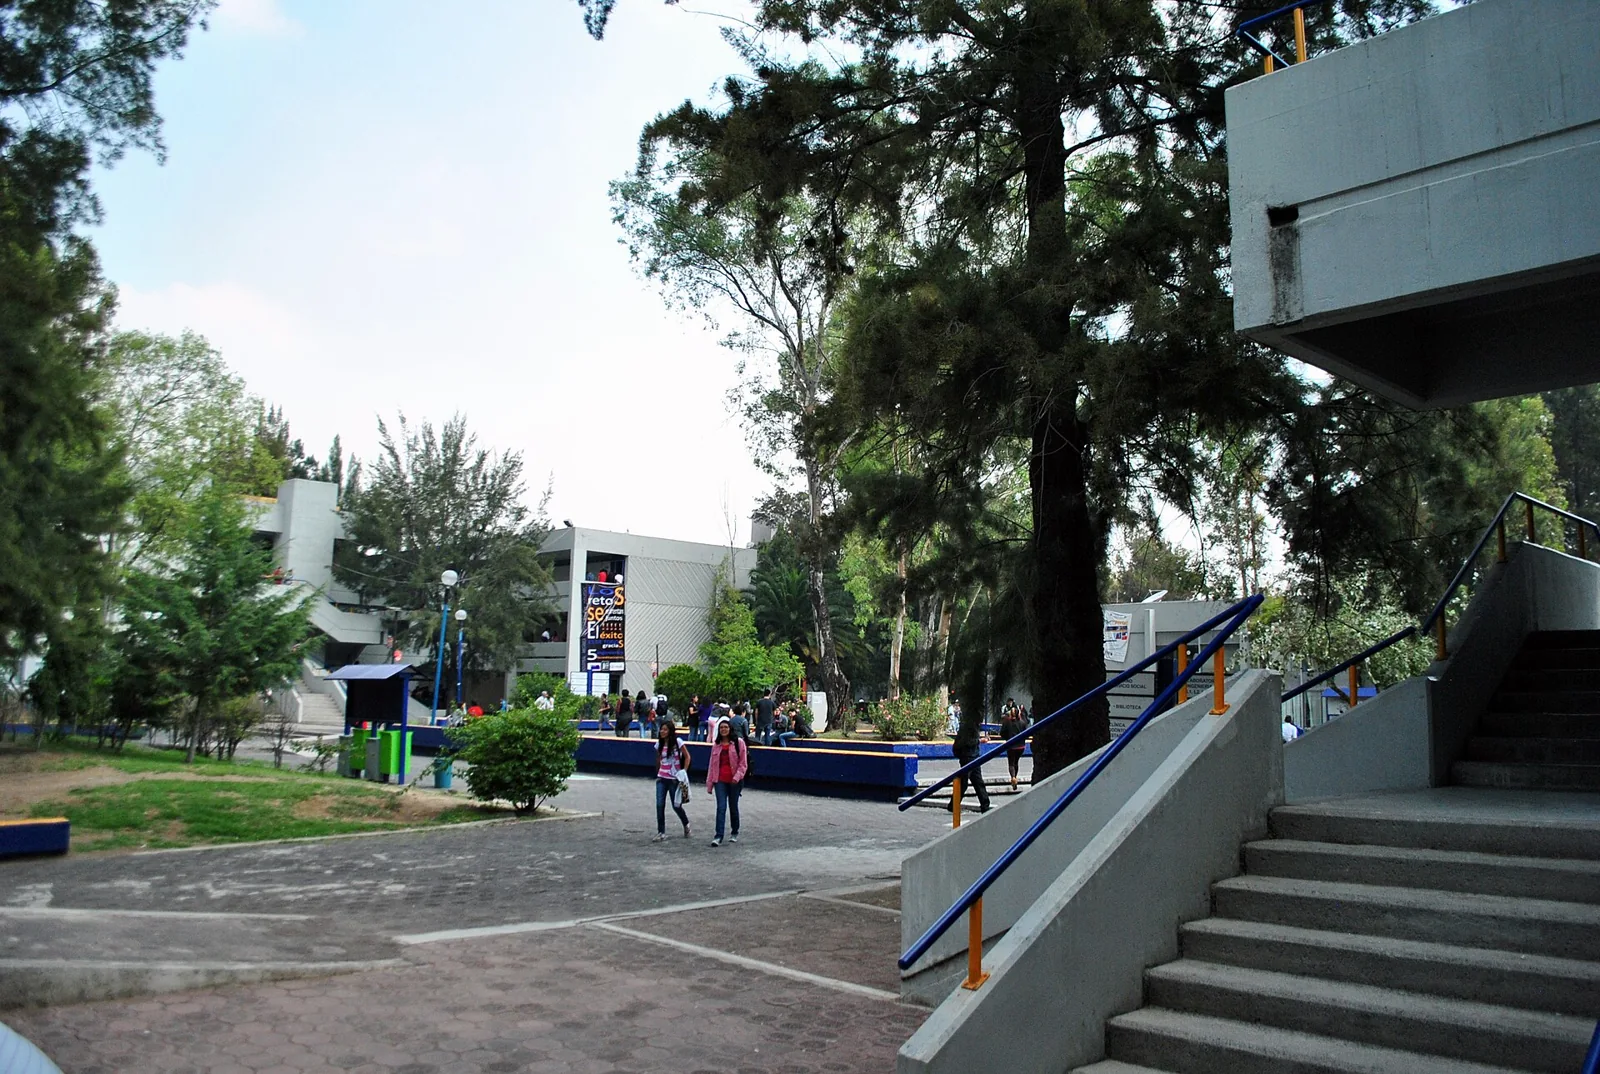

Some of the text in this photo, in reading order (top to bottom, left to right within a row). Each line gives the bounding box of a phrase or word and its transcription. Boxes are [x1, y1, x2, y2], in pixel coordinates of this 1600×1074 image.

[587, 606, 604, 621] se
[587, 620, 599, 639] El
[599, 631, 624, 639] éxito
[587, 648, 598, 661] 5
